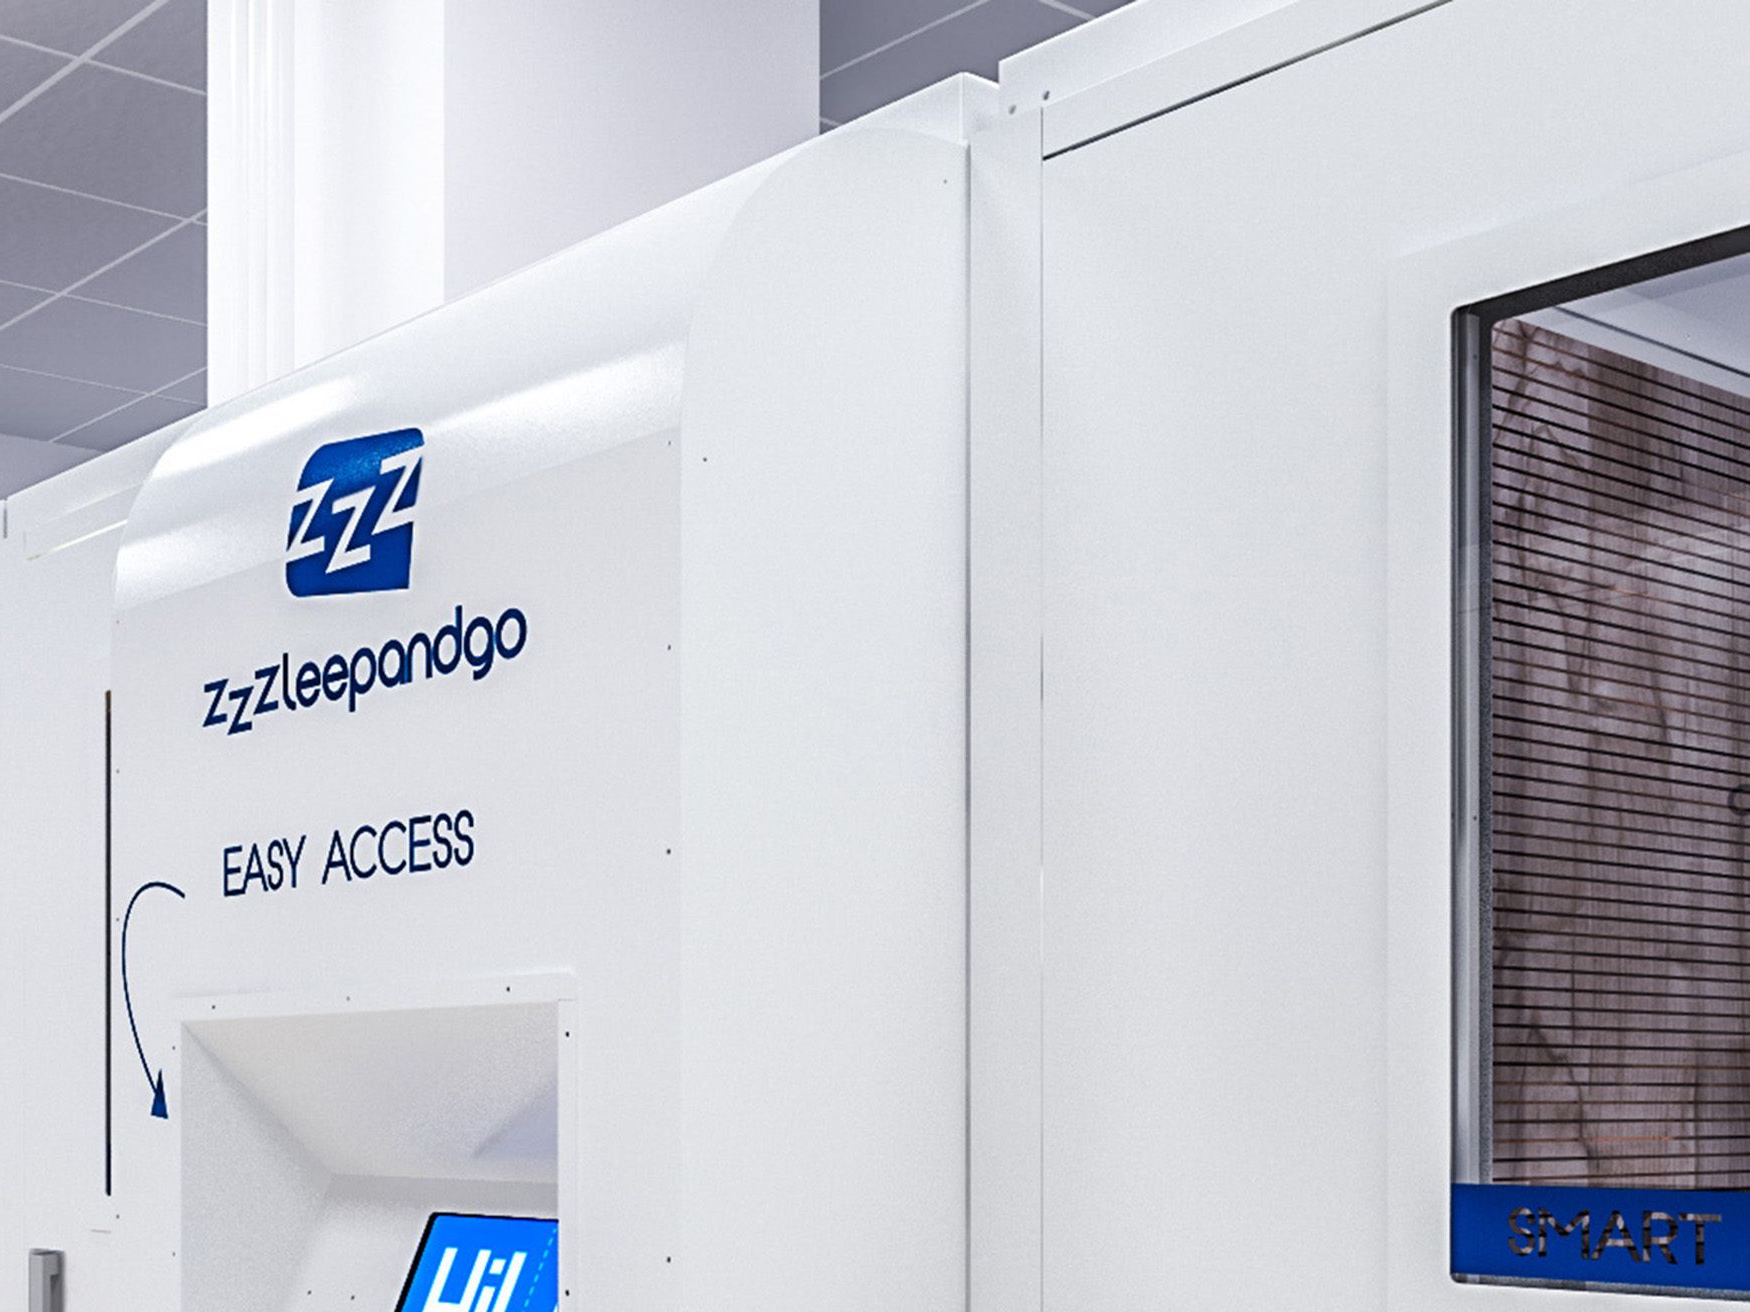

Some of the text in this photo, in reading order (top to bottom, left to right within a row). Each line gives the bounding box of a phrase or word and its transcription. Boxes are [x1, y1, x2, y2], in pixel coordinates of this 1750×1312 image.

[224, 810, 473, 897] EASY ACCESS
[1508, 1206, 1723, 1266] SMART
